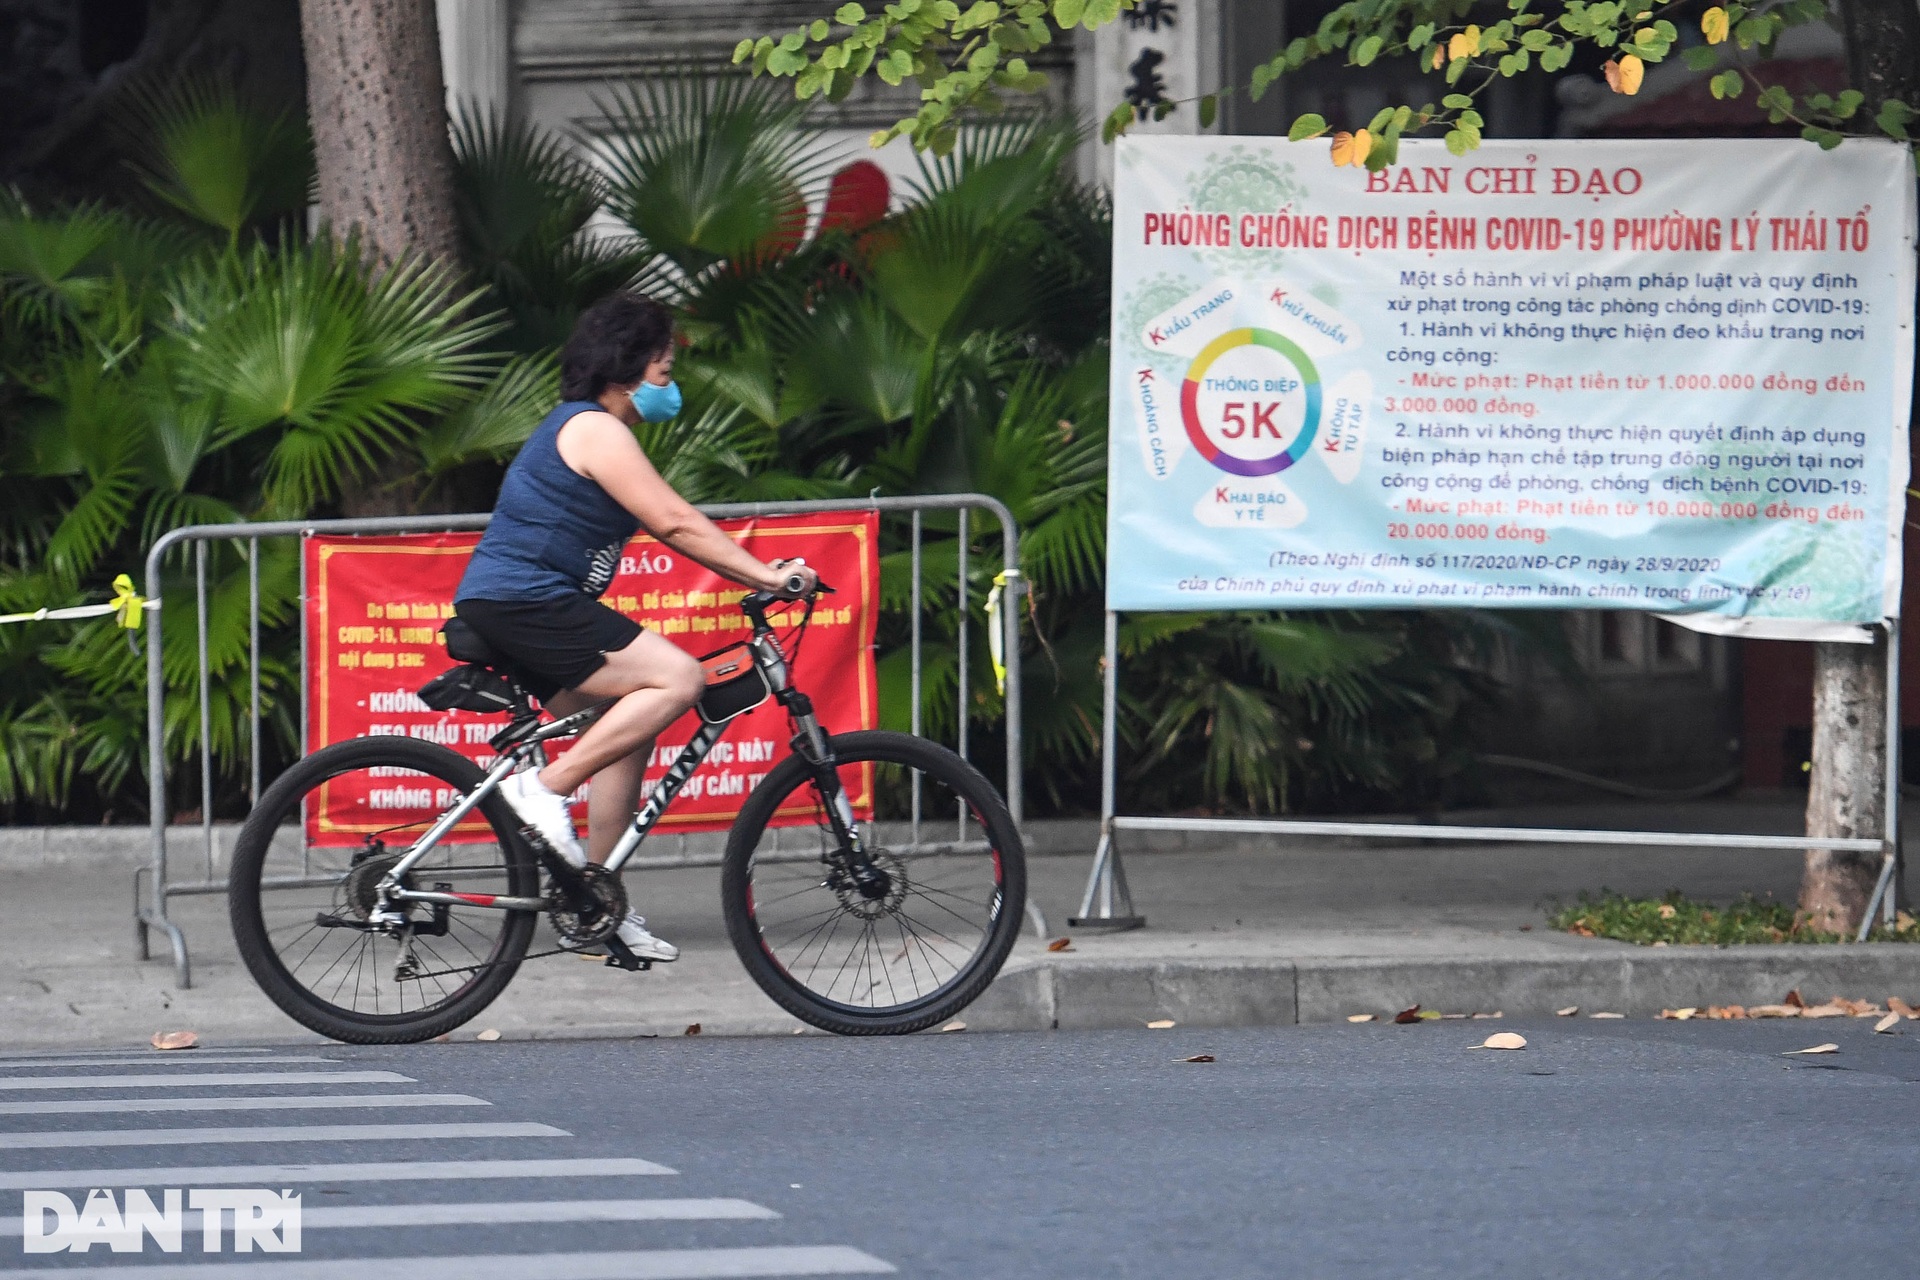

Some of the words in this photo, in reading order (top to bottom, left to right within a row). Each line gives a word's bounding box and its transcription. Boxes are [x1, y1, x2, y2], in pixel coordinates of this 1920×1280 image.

[1365, 167, 1452, 193] BAN
[1465, 153, 1536, 194] CHỈ
[1551, 168, 1643, 202] ĐẠO
[1144, 205, 1231, 247] PHÒNG
[1239, 203, 1328, 248] CHỐNG
[1337, 216, 1397, 256] DỊCH
[1407, 209, 1476, 257] BỆNH
[1486, 217, 1605, 251] COVID-19
[1613, 208, 1722, 252] PHƯỜNG
[1731, 209, 1760, 252] LÝ
[1769, 209, 1827, 252] THÁI
[1836, 203, 1871, 252] TỔ
[1400, 270, 1436, 289] Một
[1442, 267, 1466, 287] số
[1473, 271, 1522, 287] hành
[1529, 272, 1547, 287] vi
[1552, 272, 1570, 287] vi
[1576, 272, 1631, 291] phạm
[1638, 272, 1688, 291] pháp
[1695, 272, 1732, 291] luật
[1738, 272, 1762, 288] và
[1769, 275, 1805, 291] quy
[1811, 273, 1858, 292] định
[1192, 289, 1233, 321] TRANG
[1387, 297, 1412, 312] xử
[1417, 298, 1457, 315] phạt
[1462, 299, 1511, 316] trong
[1516, 298, 1562, 316] công
[1567, 299, 1595, 313] tác
[1600, 298, 1659, 317] phòng
[1665, 294, 1722, 317] chống
[1772, 298, 1870, 315] COVID-19:
[1400, 321, 1415, 337] 1.
[1422, 321, 1473, 337] Hành
[1479, 322, 1497, 337] vi
[1503, 322, 1565, 342] không
[1571, 325, 1617, 342] thực
[1624, 323, 1666, 342] hiện
[1672, 323, 1710, 339] đeo
[1716, 320, 1764, 339] khẩu
[1770, 324, 1823, 343] trang
[1830, 325, 1864, 340] nơi
[1386, 347, 1436, 366] công
[1442, 348, 1498, 366] cộng:
[1206, 376, 1259, 392] THÔNG
[1264, 377, 1299, 394] ĐIỆP
[1412, 372, 1456, 388] Mức
[1464, 373, 1517, 391] phạt:
[1526, 373, 1573, 392] Phạt
[1580, 370, 1619, 389] tiền
[1626, 374, 1650, 390] từ
[1657, 374, 1755, 390] 1.000.000
[1762, 371, 1818, 395] đồng
[1825, 372, 1866, 391] đến
[1384, 397, 1478, 413] 3.000.000
[1483, 397, 1539, 417] đồng.
[1221, 402, 1282, 439] 5K
[1395, 422, 1411, 438] 2.
[1418, 423, 1469, 438] Hành
[1476, 424, 1493, 438] vi
[1500, 424, 1561, 443] không
[1568, 425, 1613, 443] thực
[1620, 425, 1662, 443] hiện
[1669, 422, 1723, 444] quyết
[1730, 426, 1774, 444] định
[1782, 427, 1806, 444] áp
[1813, 428, 1866, 446] dụng
[1382, 449, 1424, 466] biện
[1431, 450, 1481, 467] pháp
[1488, 450, 1524, 467] hạn
[1531, 447, 1566, 465] chế
[1573, 451, 1604, 467] tập
[1611, 453, 1662, 468] trung
[1669, 451, 1721, 470] đông
[1728, 452, 1791, 471] người
[1798, 453, 1823, 471] tại
[1830, 454, 1864, 469] nơi
[1381, 474, 1429, 491] công
[1435, 475, 1483, 493] cộng
[1489, 472, 1511, 489] để
[1591, 472, 1649, 494] chống
[1662, 476, 1704, 494] dịch
[1710, 477, 1760, 495] bệnh
[1766, 478, 1867, 495] COVID-19:
[1216, 487, 1253, 504] KHAI
[1257, 490, 1286, 505] BÁO
[1235, 509, 1243, 520] Y
[1406, 499, 1449, 513] Mức
[1517, 500, 1564, 518] Phạt
[1570, 497, 1609, 515] tiền
[1616, 500, 1639, 516] từ
[1646, 501, 1757, 519] 10.000.000
[1764, 500, 1819, 523] đồng
[1826, 503, 1864, 521] đến
[1387, 523, 1489, 539] 20.000.000
[1495, 521, 1551, 544] đồng.
[620, 551, 673, 575] BÁO
[1269, 551, 1318, 568] (Theo
[1416, 552, 1437, 567] số
[1442, 555, 1581, 569] 117/2020/NĐ-CP
[1587, 557, 1630, 573] ngày
[1635, 557, 1721, 572] 28/9/2020
[1178, 576, 1209, 590] của
[1309, 581, 1340, 595] quy
[1538, 584, 1581, 598] hành
[1644, 585, 1690, 603] trong
[737, 738, 774, 763] NÀY
[369, 785, 431, 809] KHÔNG
